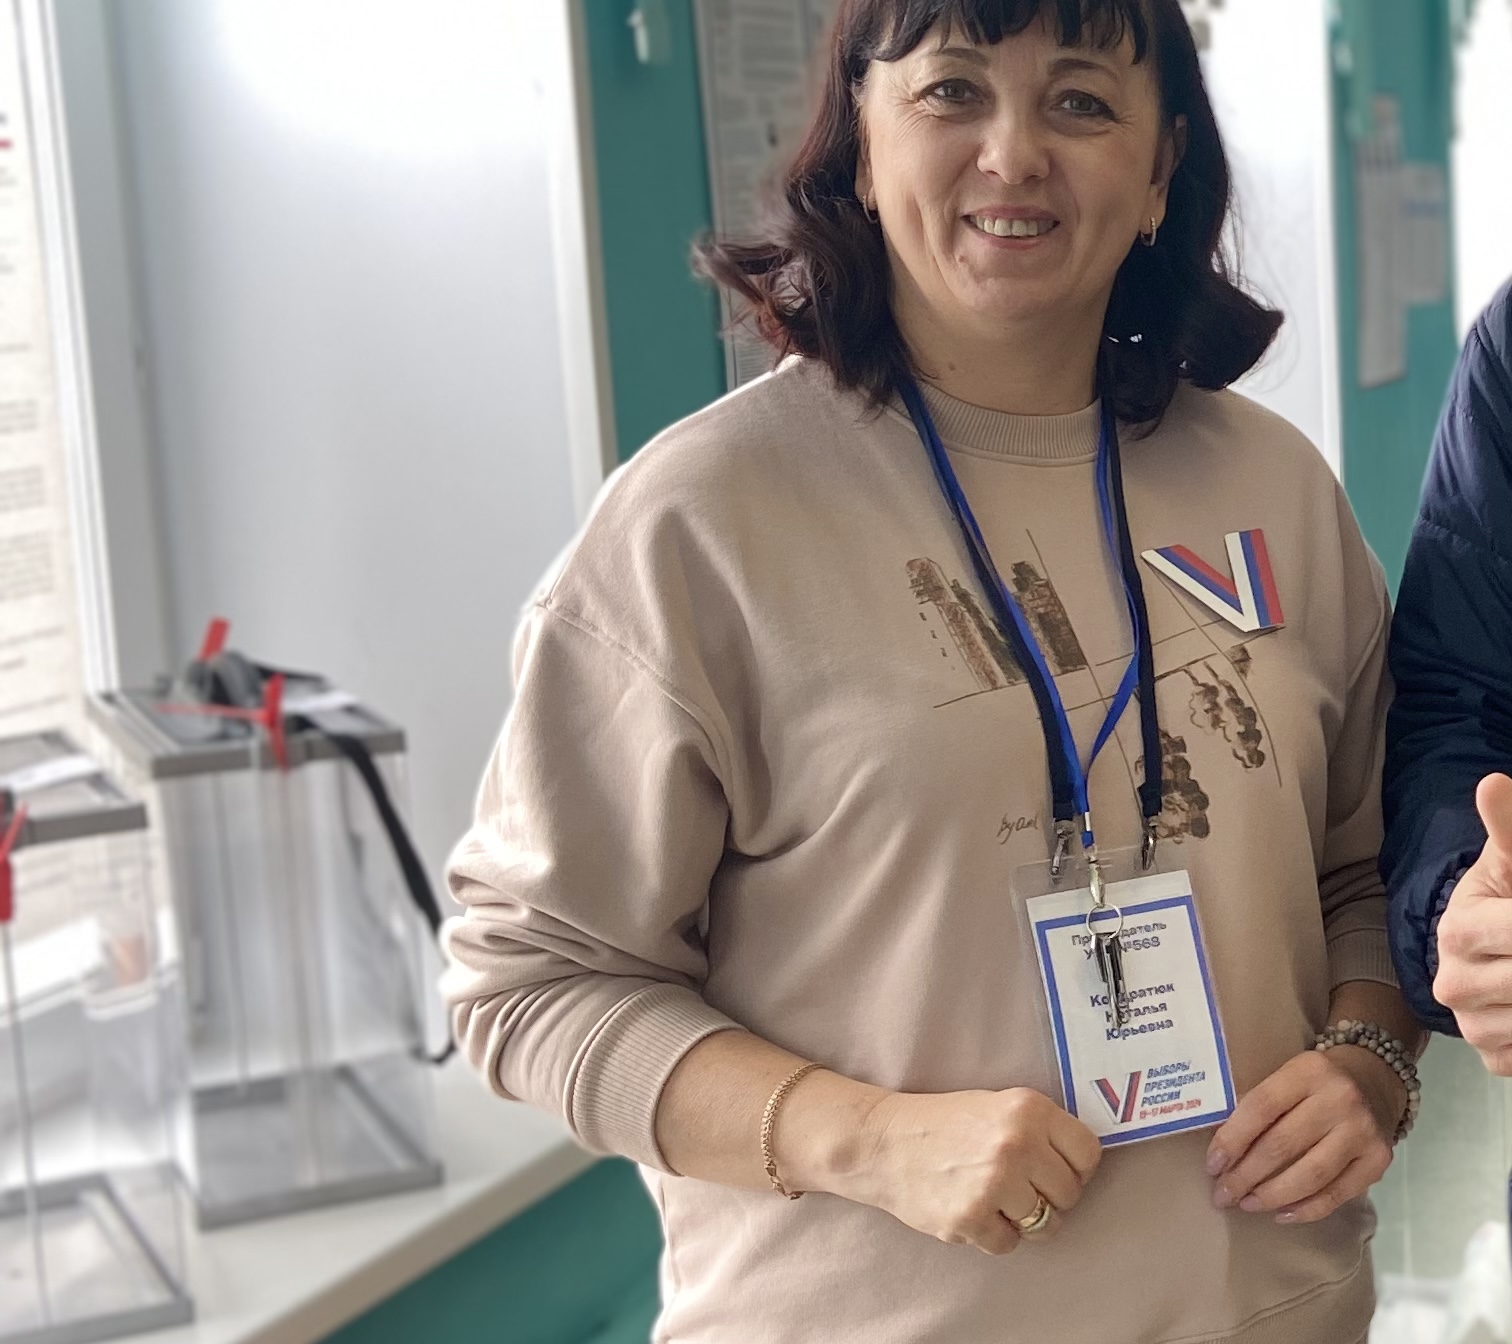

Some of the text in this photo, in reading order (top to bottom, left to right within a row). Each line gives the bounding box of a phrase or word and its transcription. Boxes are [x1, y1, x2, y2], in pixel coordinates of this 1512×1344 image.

[1106, 1019, 1174, 1040] Юрьевна
[1147, 1060, 1192, 1079] ВЫБОРЫ
[1144, 1070, 1206, 1093] ПРЕЗИДЕНТА
[1141, 1089, 1181, 1107] РОССИИ
